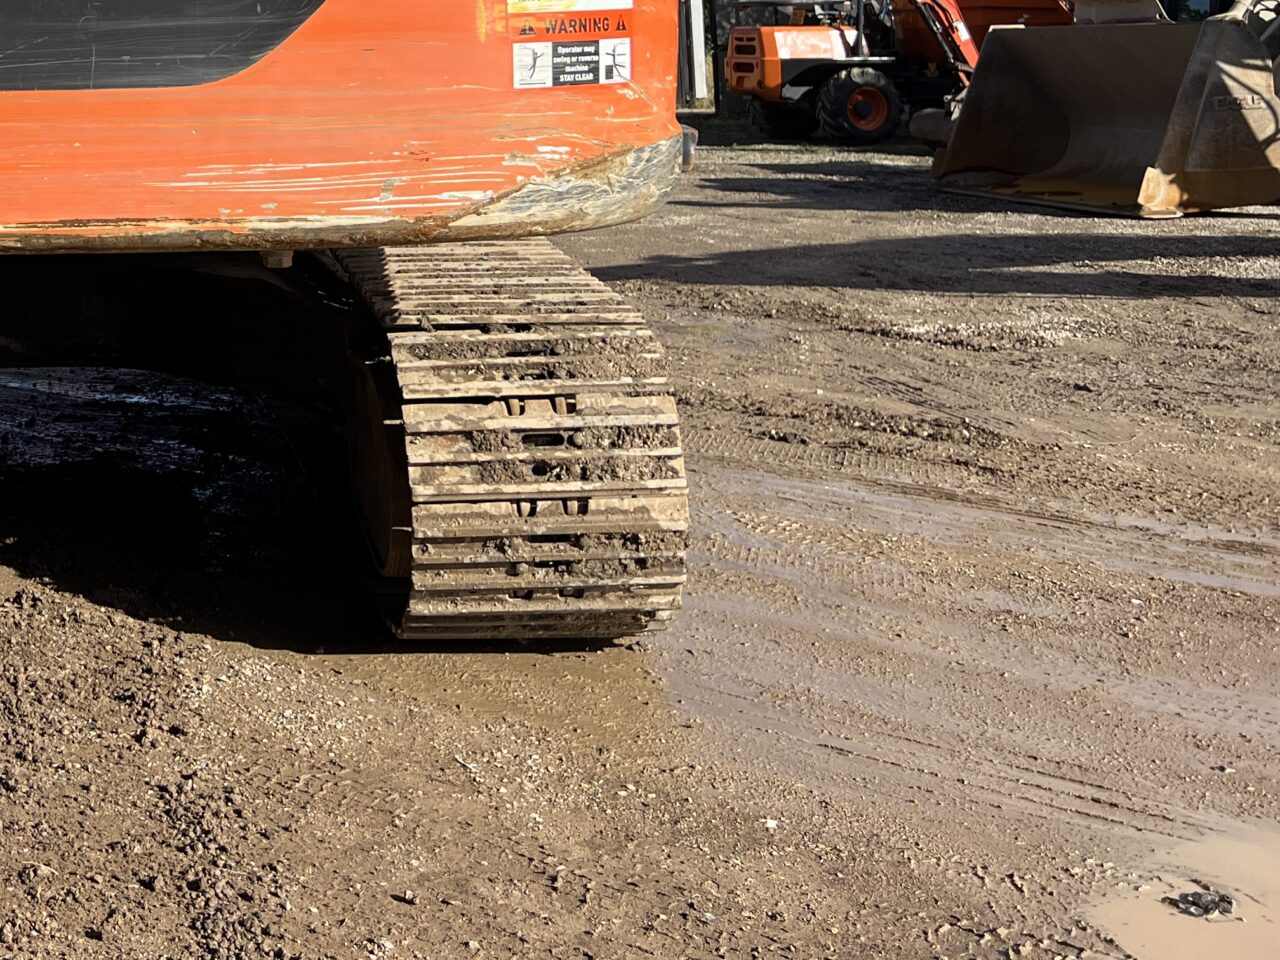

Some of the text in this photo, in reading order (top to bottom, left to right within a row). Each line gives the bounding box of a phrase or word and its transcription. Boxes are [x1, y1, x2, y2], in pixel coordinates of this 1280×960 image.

[545, 17, 610, 34] WARNING
[559, 72, 594, 82] STAY CLEAR
